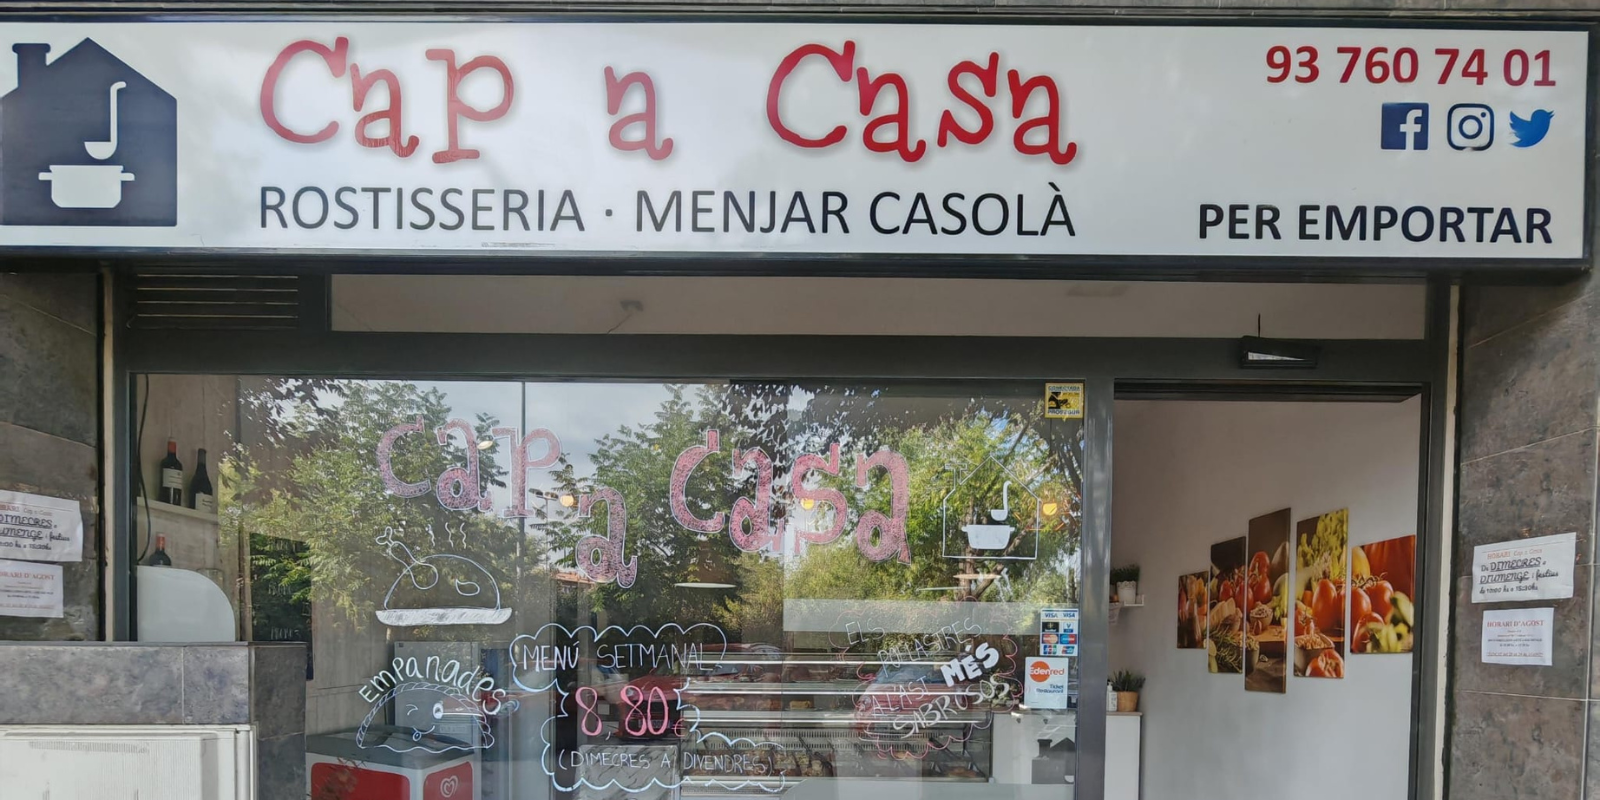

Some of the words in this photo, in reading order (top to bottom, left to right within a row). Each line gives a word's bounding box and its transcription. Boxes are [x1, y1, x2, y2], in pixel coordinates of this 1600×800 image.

[1266, 45, 1319, 84] 93
[1337, 46, 1419, 84] 760
[1434, 48, 1488, 86] 74
[1503, 49, 1555, 87] 01
[261, 37, 513, 163] Cap
[605, 66, 673, 160] a
[766, 40, 1077, 165] Casa
[260, 186, 585, 232] ROSTISSERIA
[636, 190, 850, 234] MENJAR
[869, 182, 1076, 237] CASOLÀ
[1199, 203, 1282, 241] PER
[1298, 204, 1553, 245] EMPORTAR
[1480, 571, 1530, 583] DIUMENGE
[1490, 557, 1541, 572] DIMECRES
[845, 616, 885, 645] ELS
[523, 641, 579, 672] MENÚ
[597, 643, 714, 671] SETMANAL
[940, 642, 999, 687] MÉS
[1029, 667, 1065, 675] Edenred
